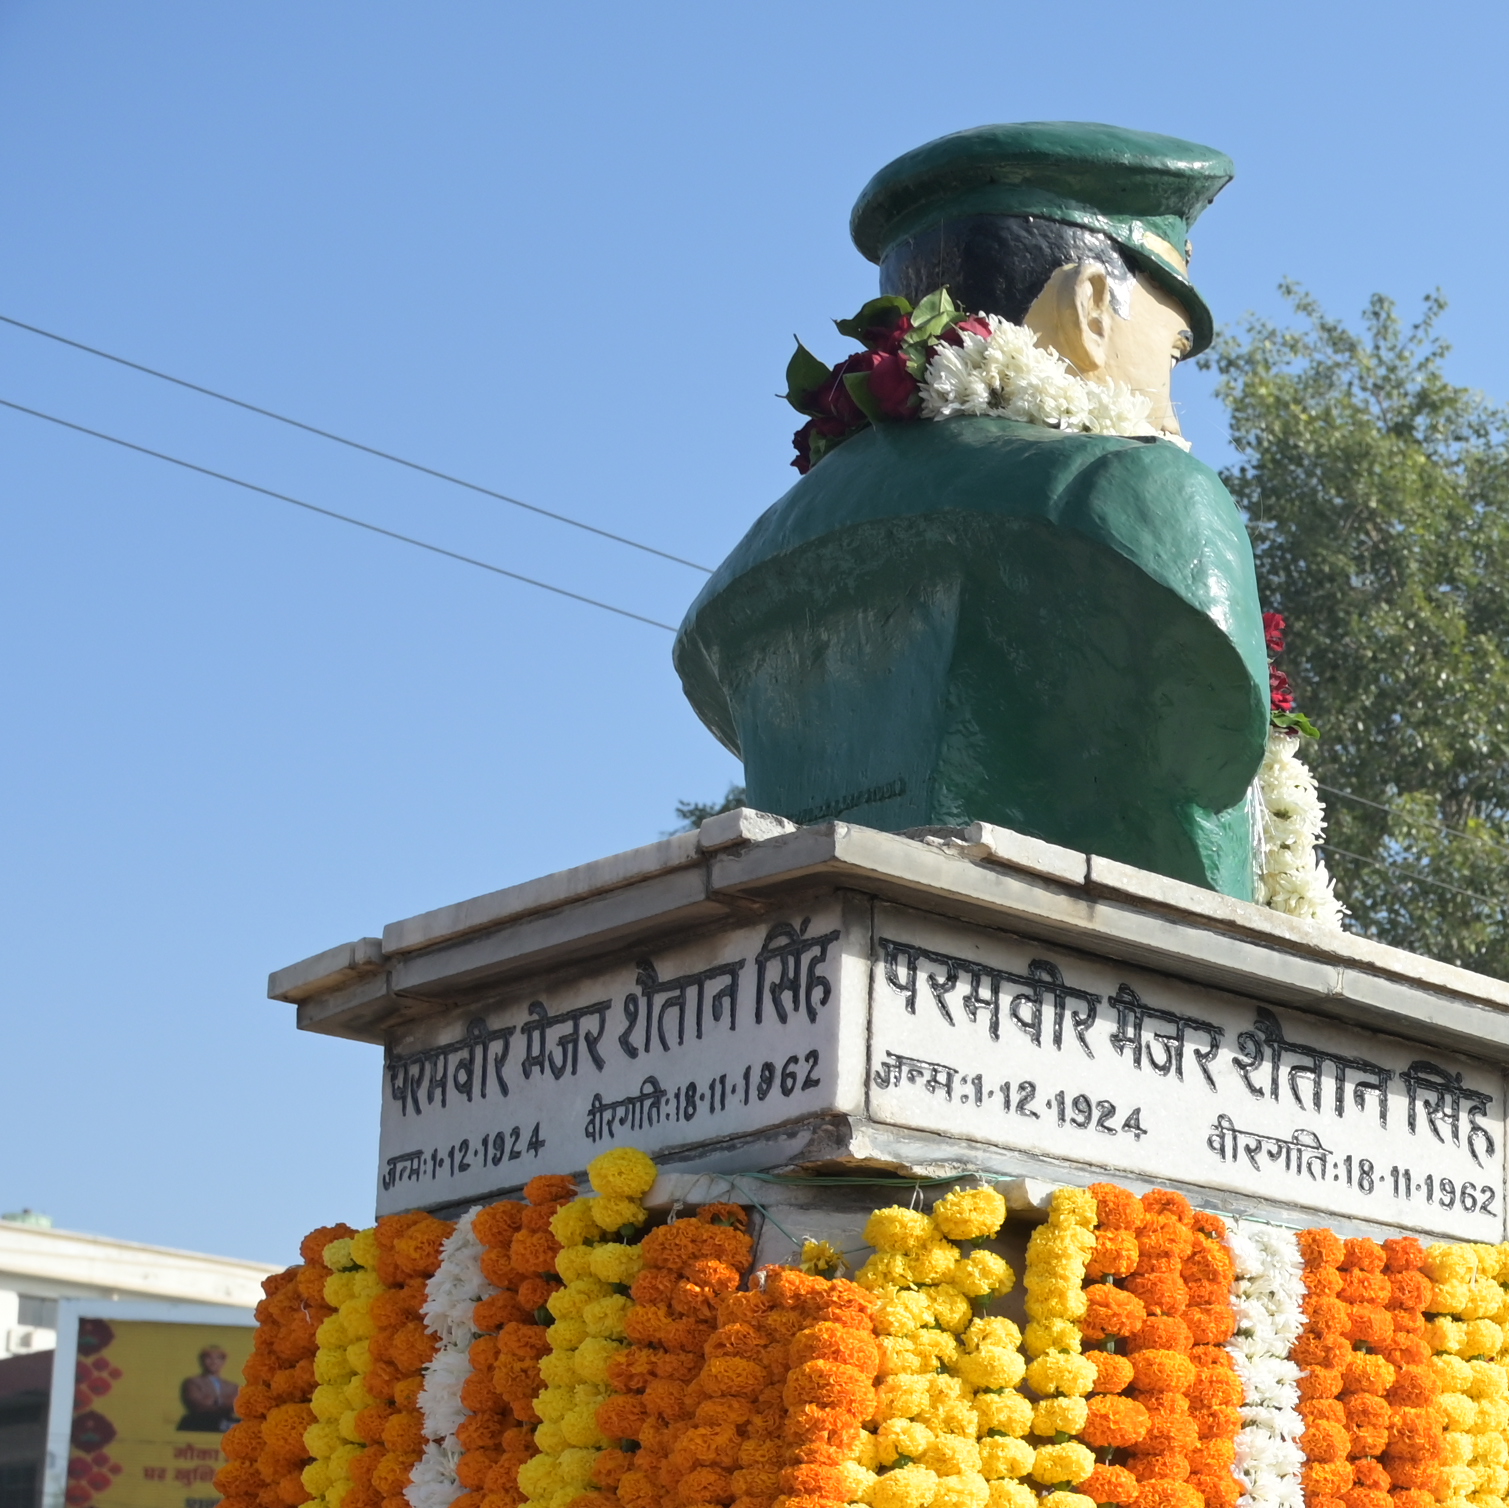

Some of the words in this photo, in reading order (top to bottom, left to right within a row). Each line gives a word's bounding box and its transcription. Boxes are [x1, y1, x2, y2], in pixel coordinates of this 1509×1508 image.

[387, 1017, 516, 1117] परमवीर
[521, 1000, 613, 1080] मेजर
[618, 955, 747, 1060] शैतान
[755, 916, 841, 1025] सिंह
[879, 937, 1103, 1060] परमवीर
[1232, 1005, 1396, 1130] शैतान
[1399, 1059, 1495, 1169] सिंह
